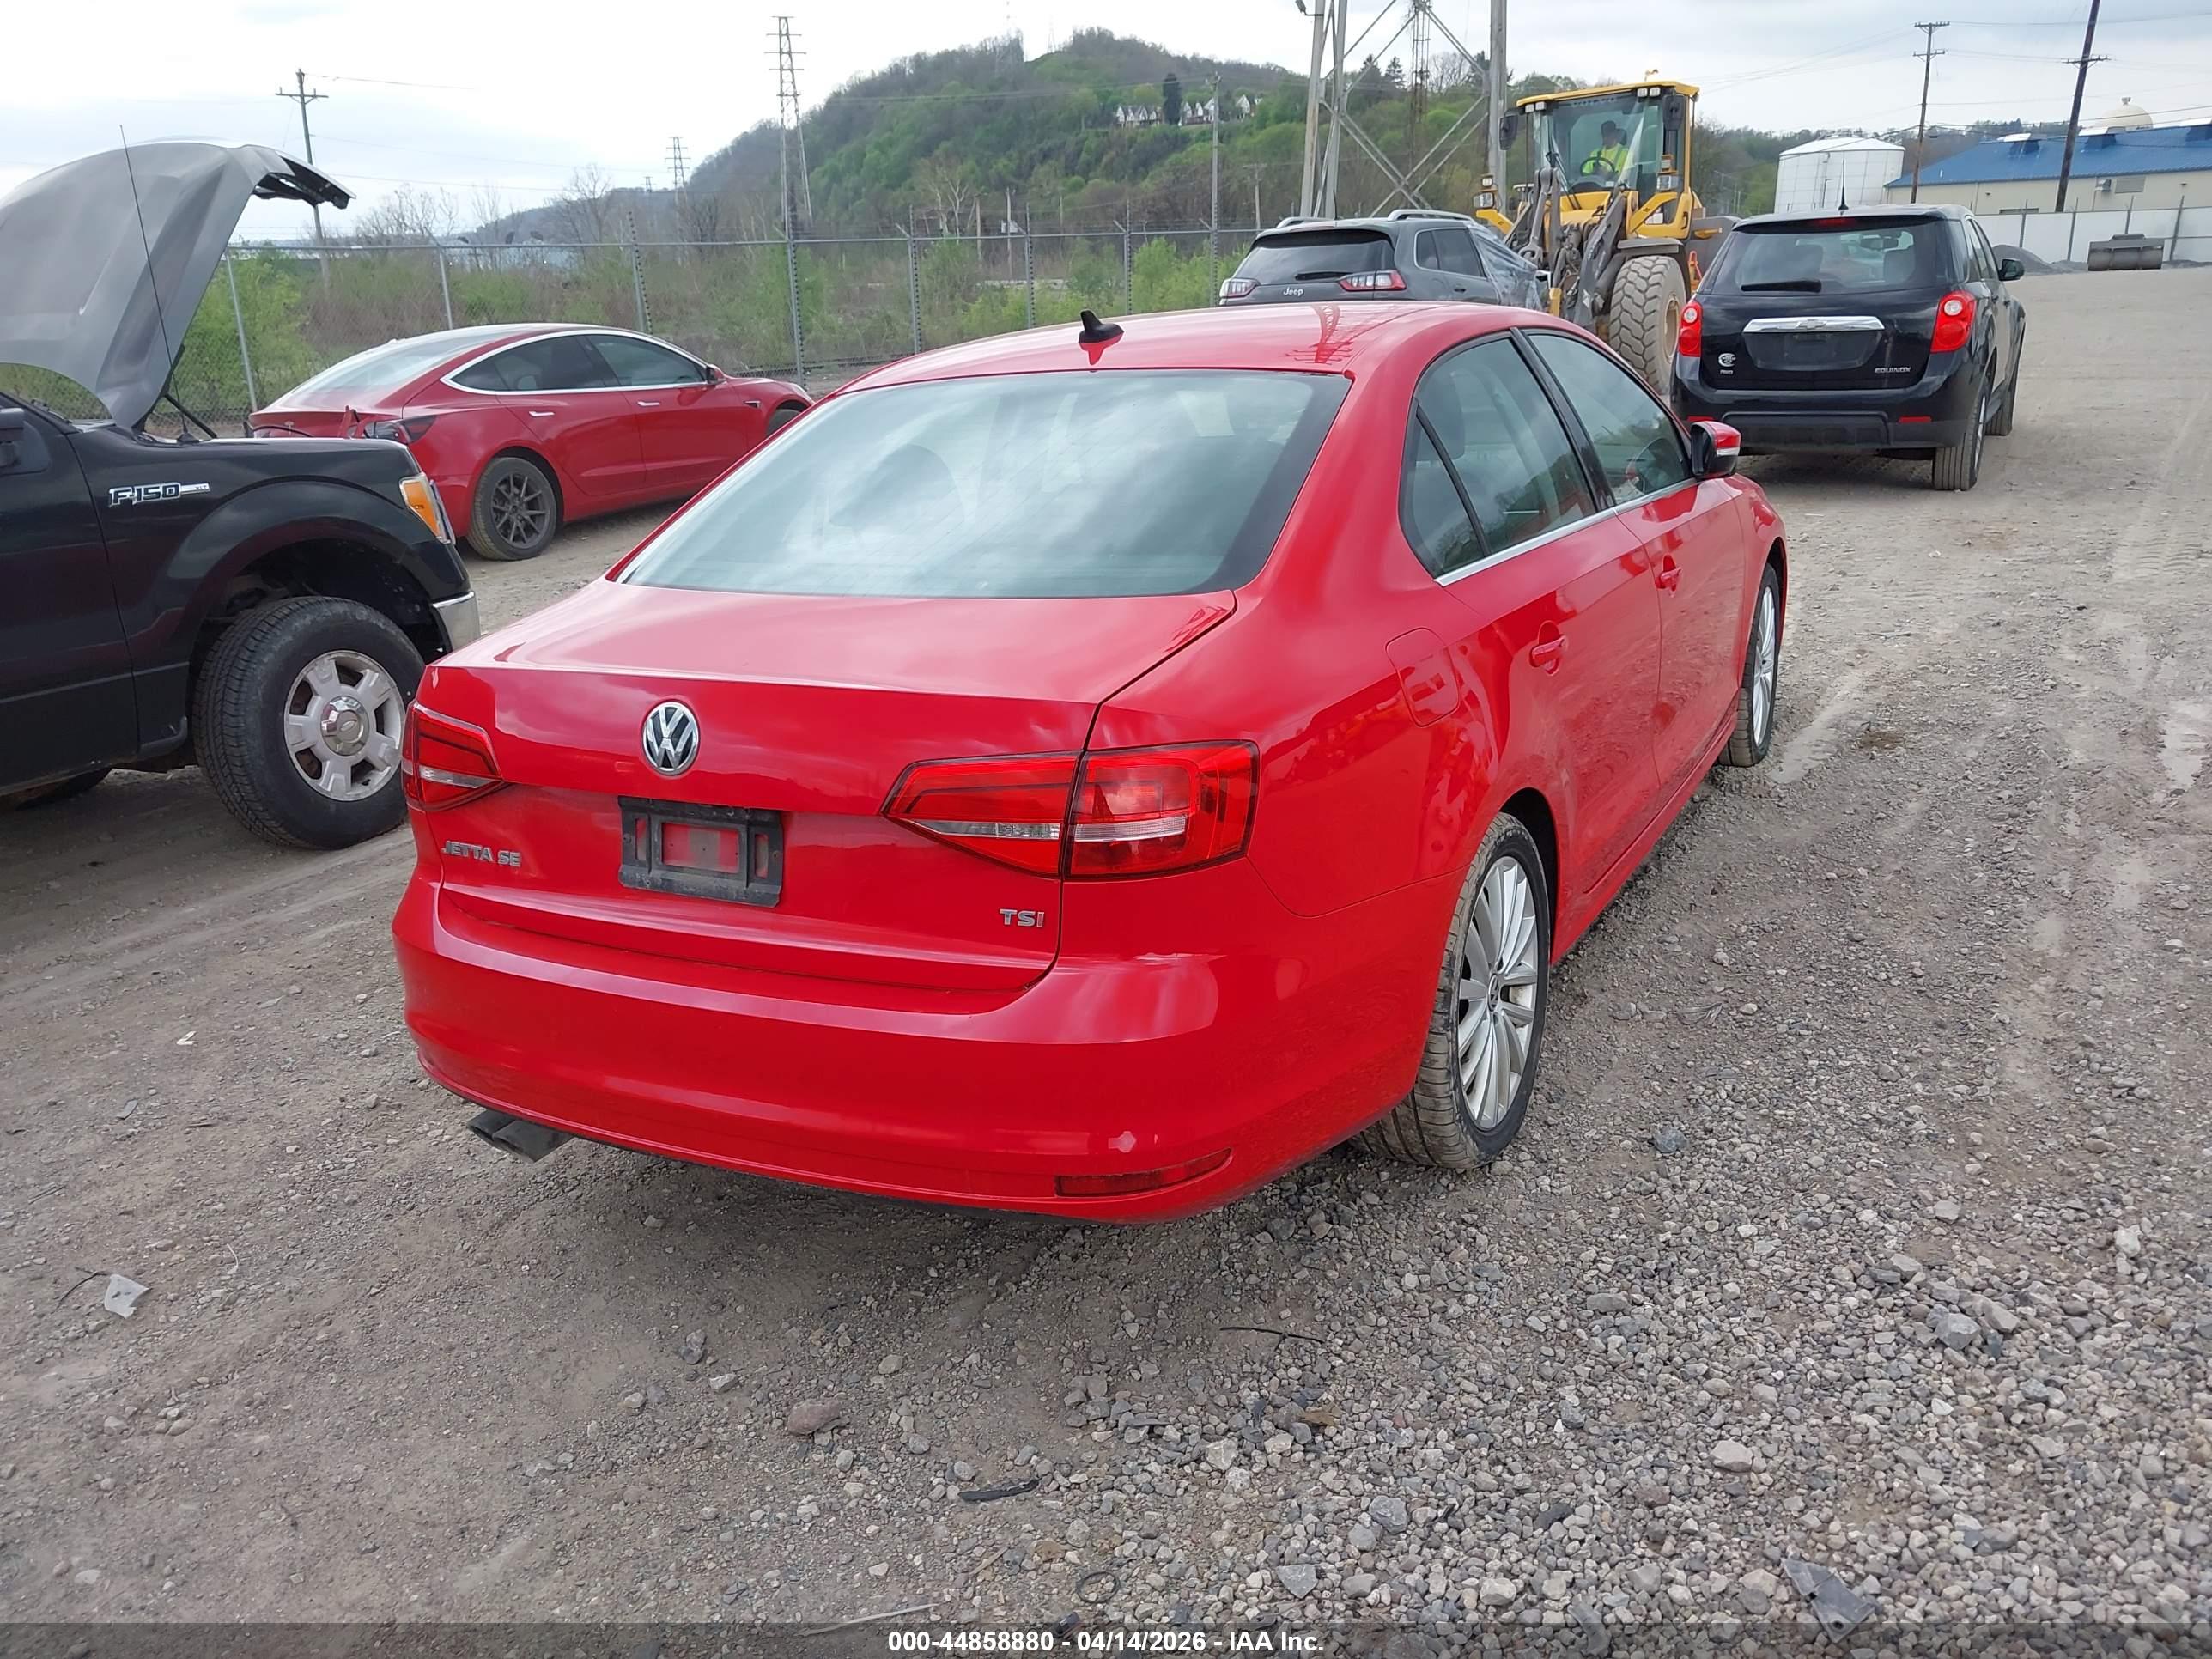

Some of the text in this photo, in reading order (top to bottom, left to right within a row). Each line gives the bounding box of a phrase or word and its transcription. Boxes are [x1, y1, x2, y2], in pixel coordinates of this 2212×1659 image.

[1283, 286, 1304, 297] Jeep
[441, 840, 521, 867] JETTA SE
[999, 908, 1045, 928] TSI
